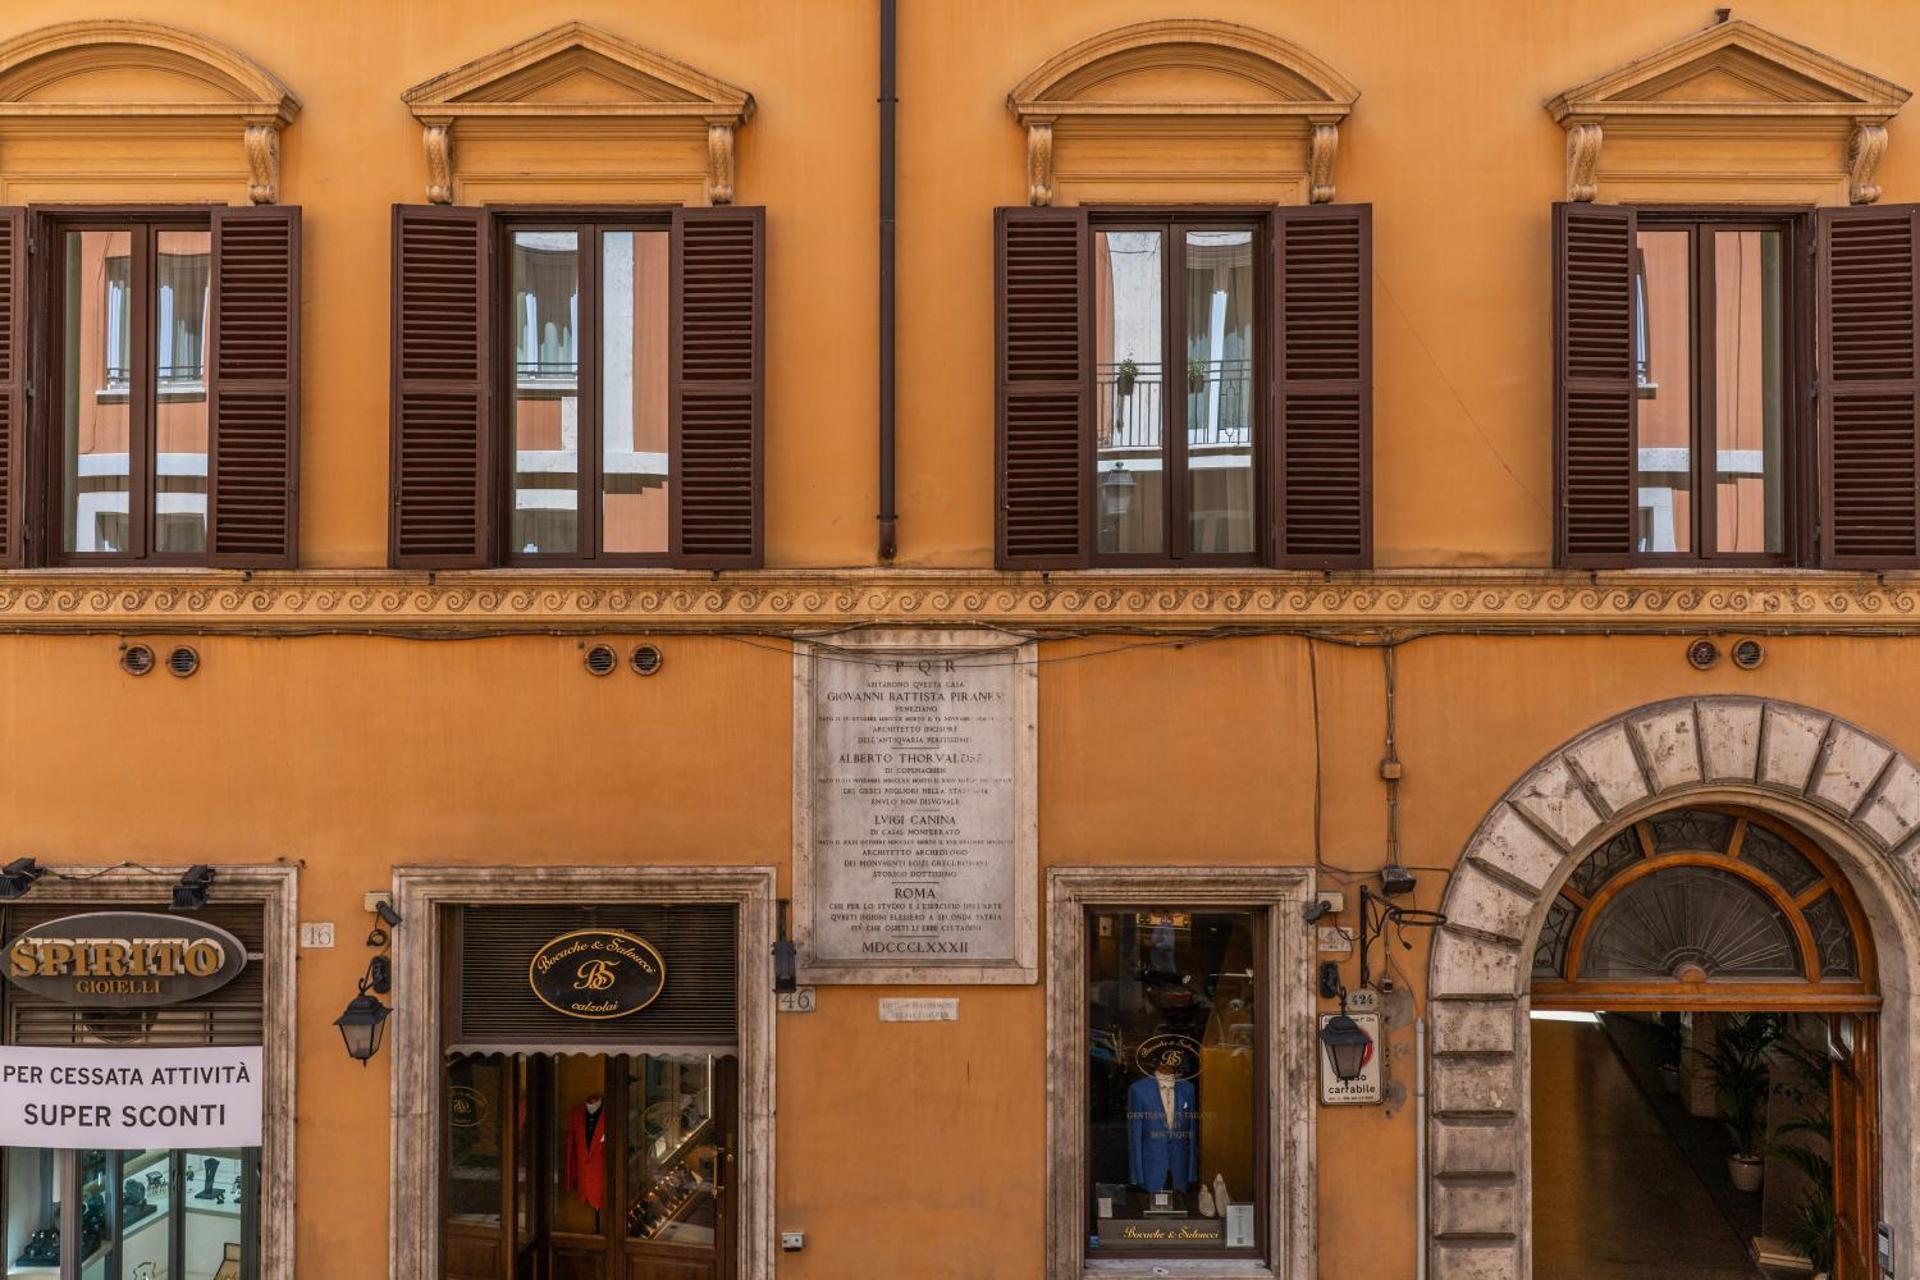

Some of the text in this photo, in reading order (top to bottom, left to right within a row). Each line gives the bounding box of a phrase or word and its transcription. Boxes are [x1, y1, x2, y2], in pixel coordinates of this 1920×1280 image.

[827, 691, 884, 702] GIOVANNI
[888, 691, 945, 702] BATTISTA
[839, 753, 893, 763] ALBERTO
[874, 815, 956, 825] LVIGI CANINA
[894, 887, 936, 899] ROMA
[308, 925, 332, 945] 16
[590, 940, 605, 950] &
[862, 942, 969, 953] MDCCCLXXXII
[10, 939, 222, 978] SPIRITO
[76, 980, 161, 994] GIOIELLI
[781, 988, 814, 1009] 46
[571, 1001, 619, 1012] calzolai
[3, 1061, 251, 1086] PER CESSATA ATTIVITÀ
[1328, 1085, 1376, 1095] carrabile
[23, 1103, 226, 1128] SUPER SCONTI
